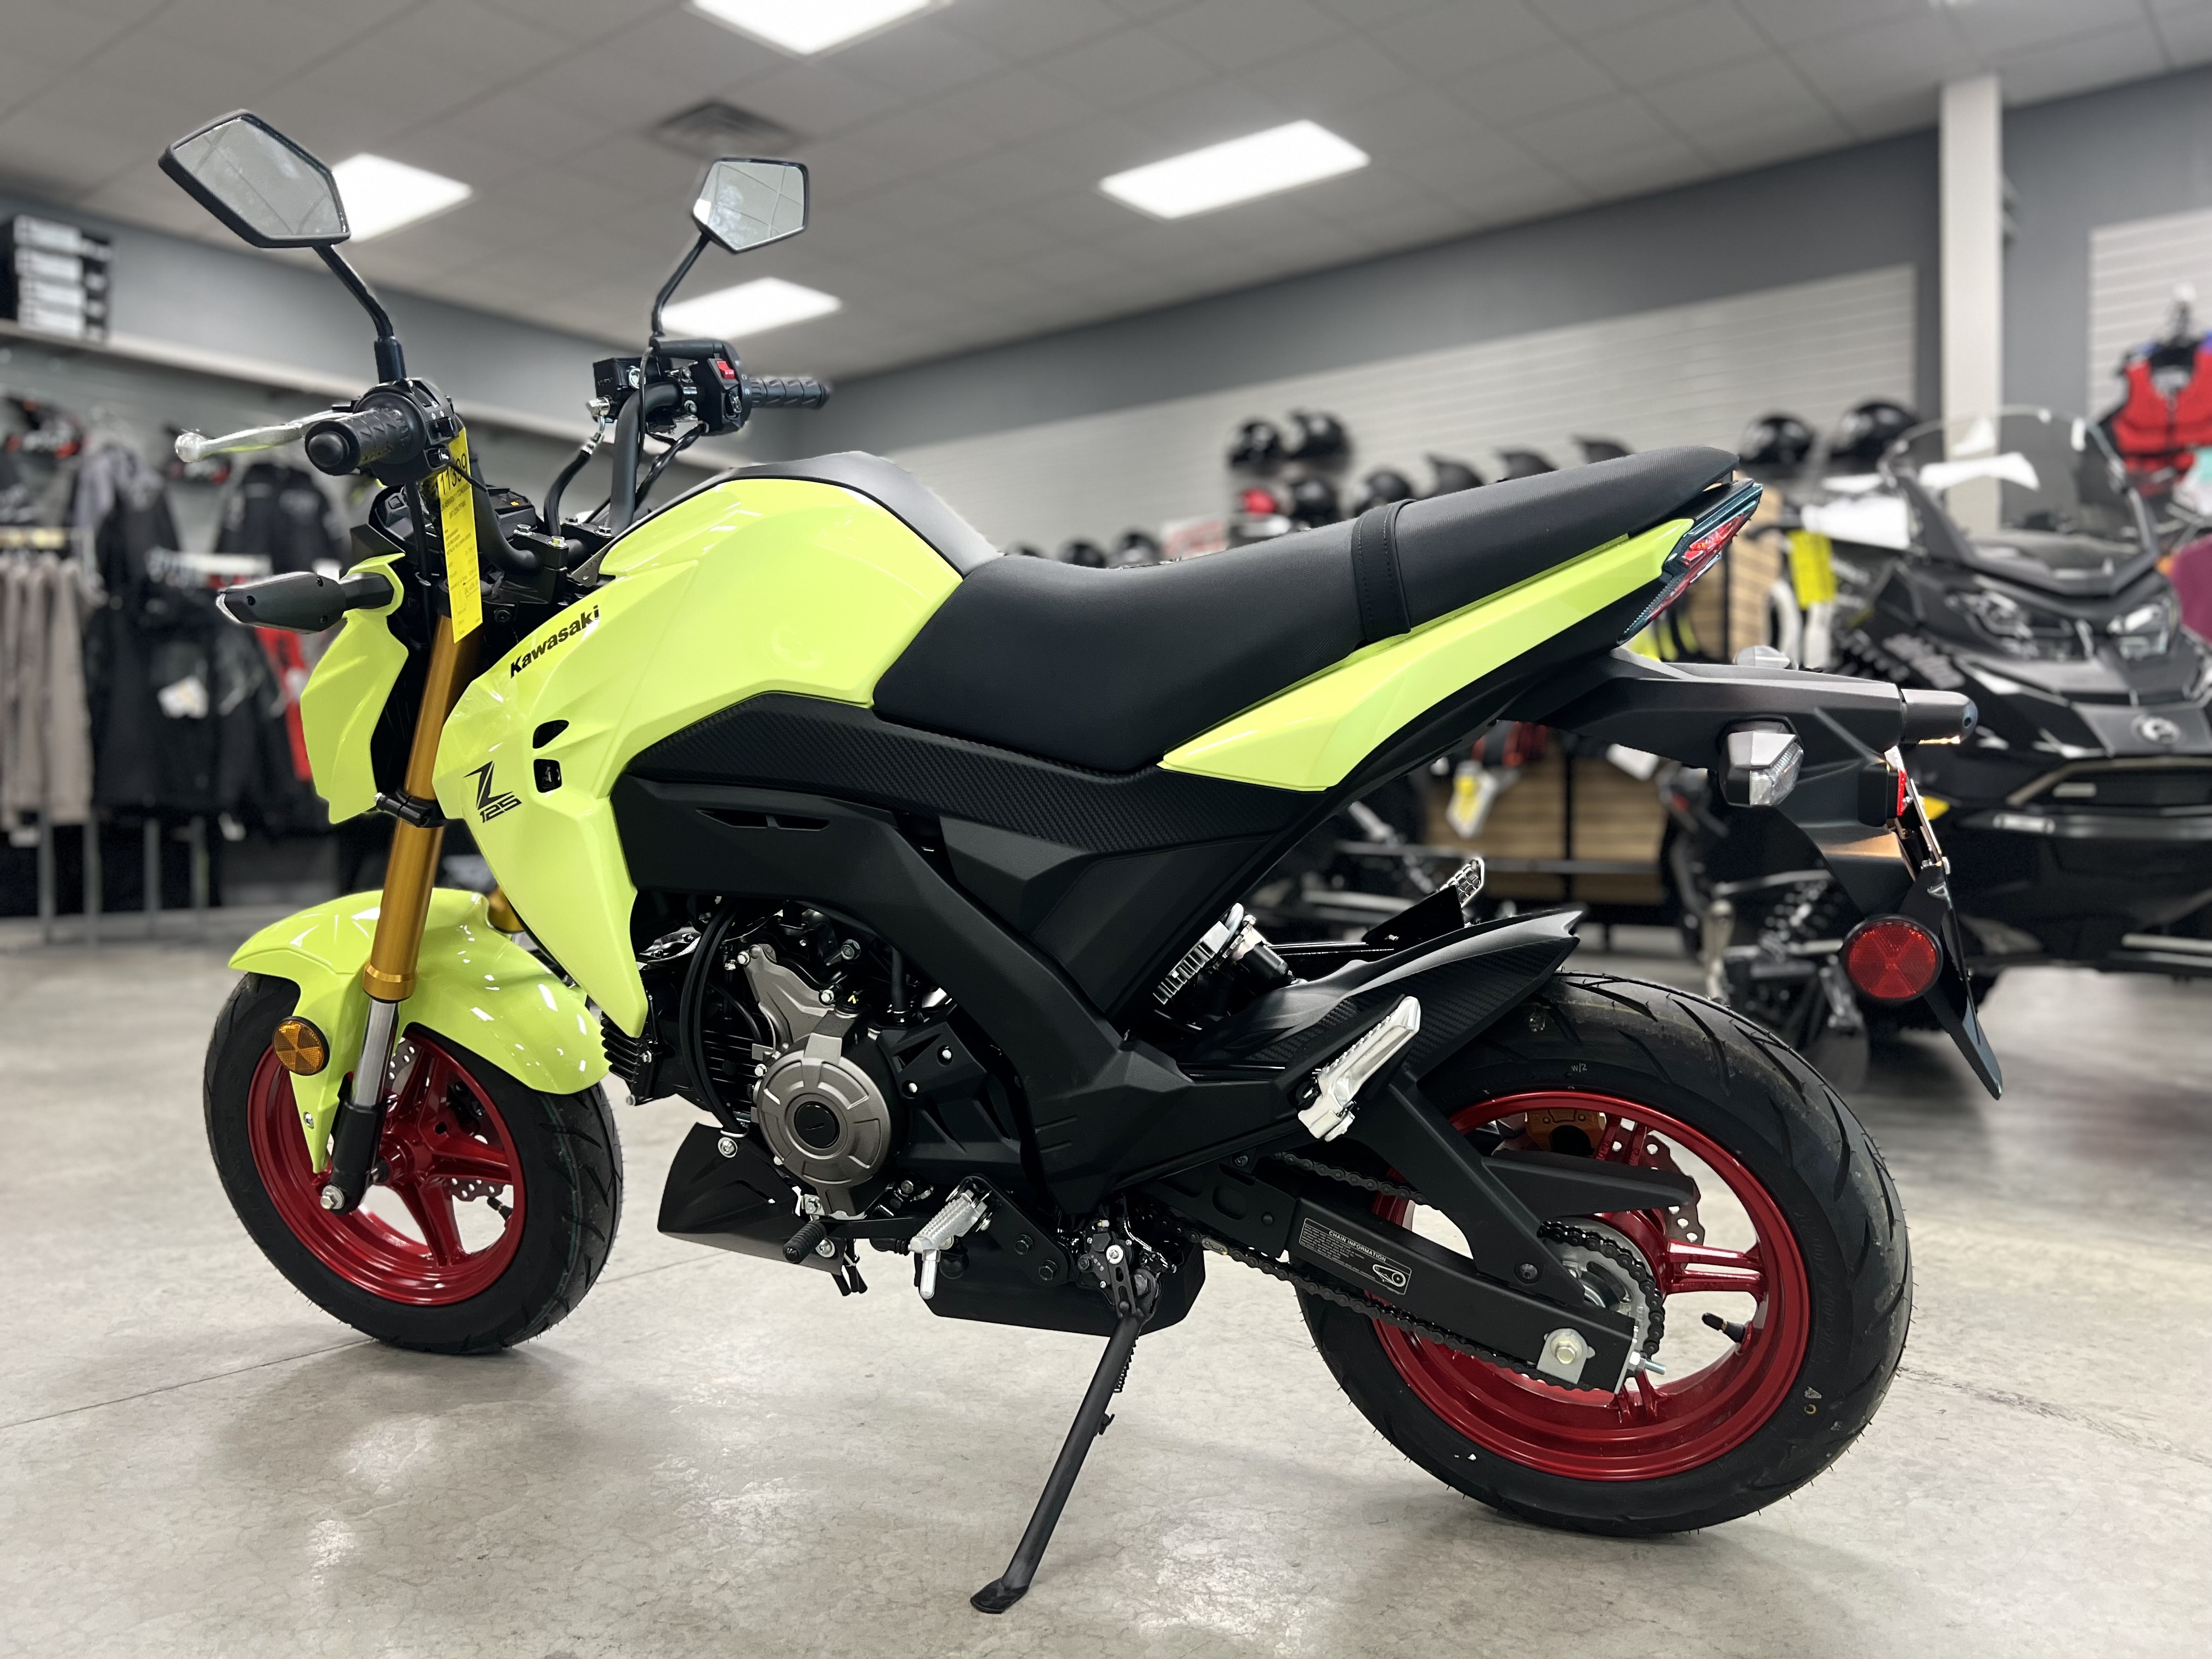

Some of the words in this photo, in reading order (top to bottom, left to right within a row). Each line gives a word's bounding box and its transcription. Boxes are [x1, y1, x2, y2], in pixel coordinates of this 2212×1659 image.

[510, 604, 600, 679] Kawasaki
[463, 760, 514, 810] Z
[479, 795, 522, 823] 125
[1329, 1231, 1346, 1243] CHAIN
[1347, 1239, 1386, 1262] INFORMATION
